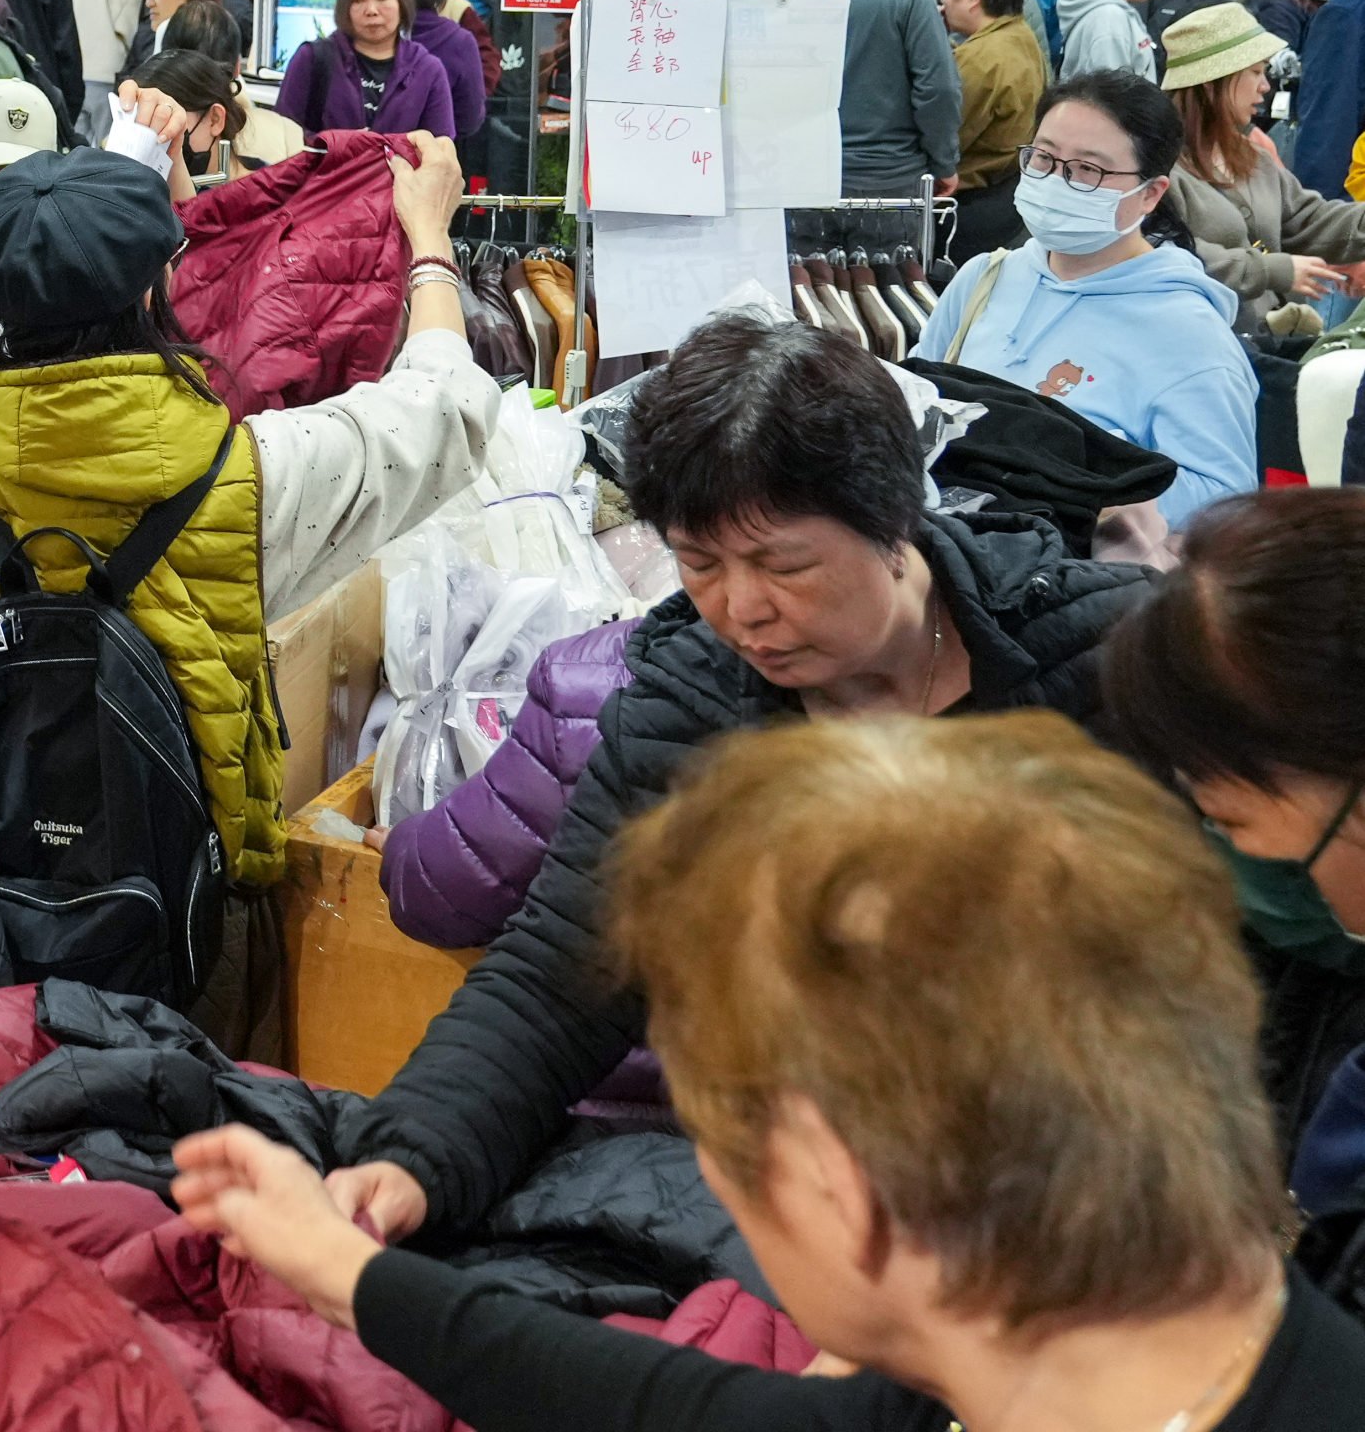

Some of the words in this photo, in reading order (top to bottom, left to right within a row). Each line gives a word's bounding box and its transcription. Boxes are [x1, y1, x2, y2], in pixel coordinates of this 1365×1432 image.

[615, 106, 691, 142] $80
[33, 819, 84, 836] Onitsuka
[40, 832, 73, 847] Tiger
